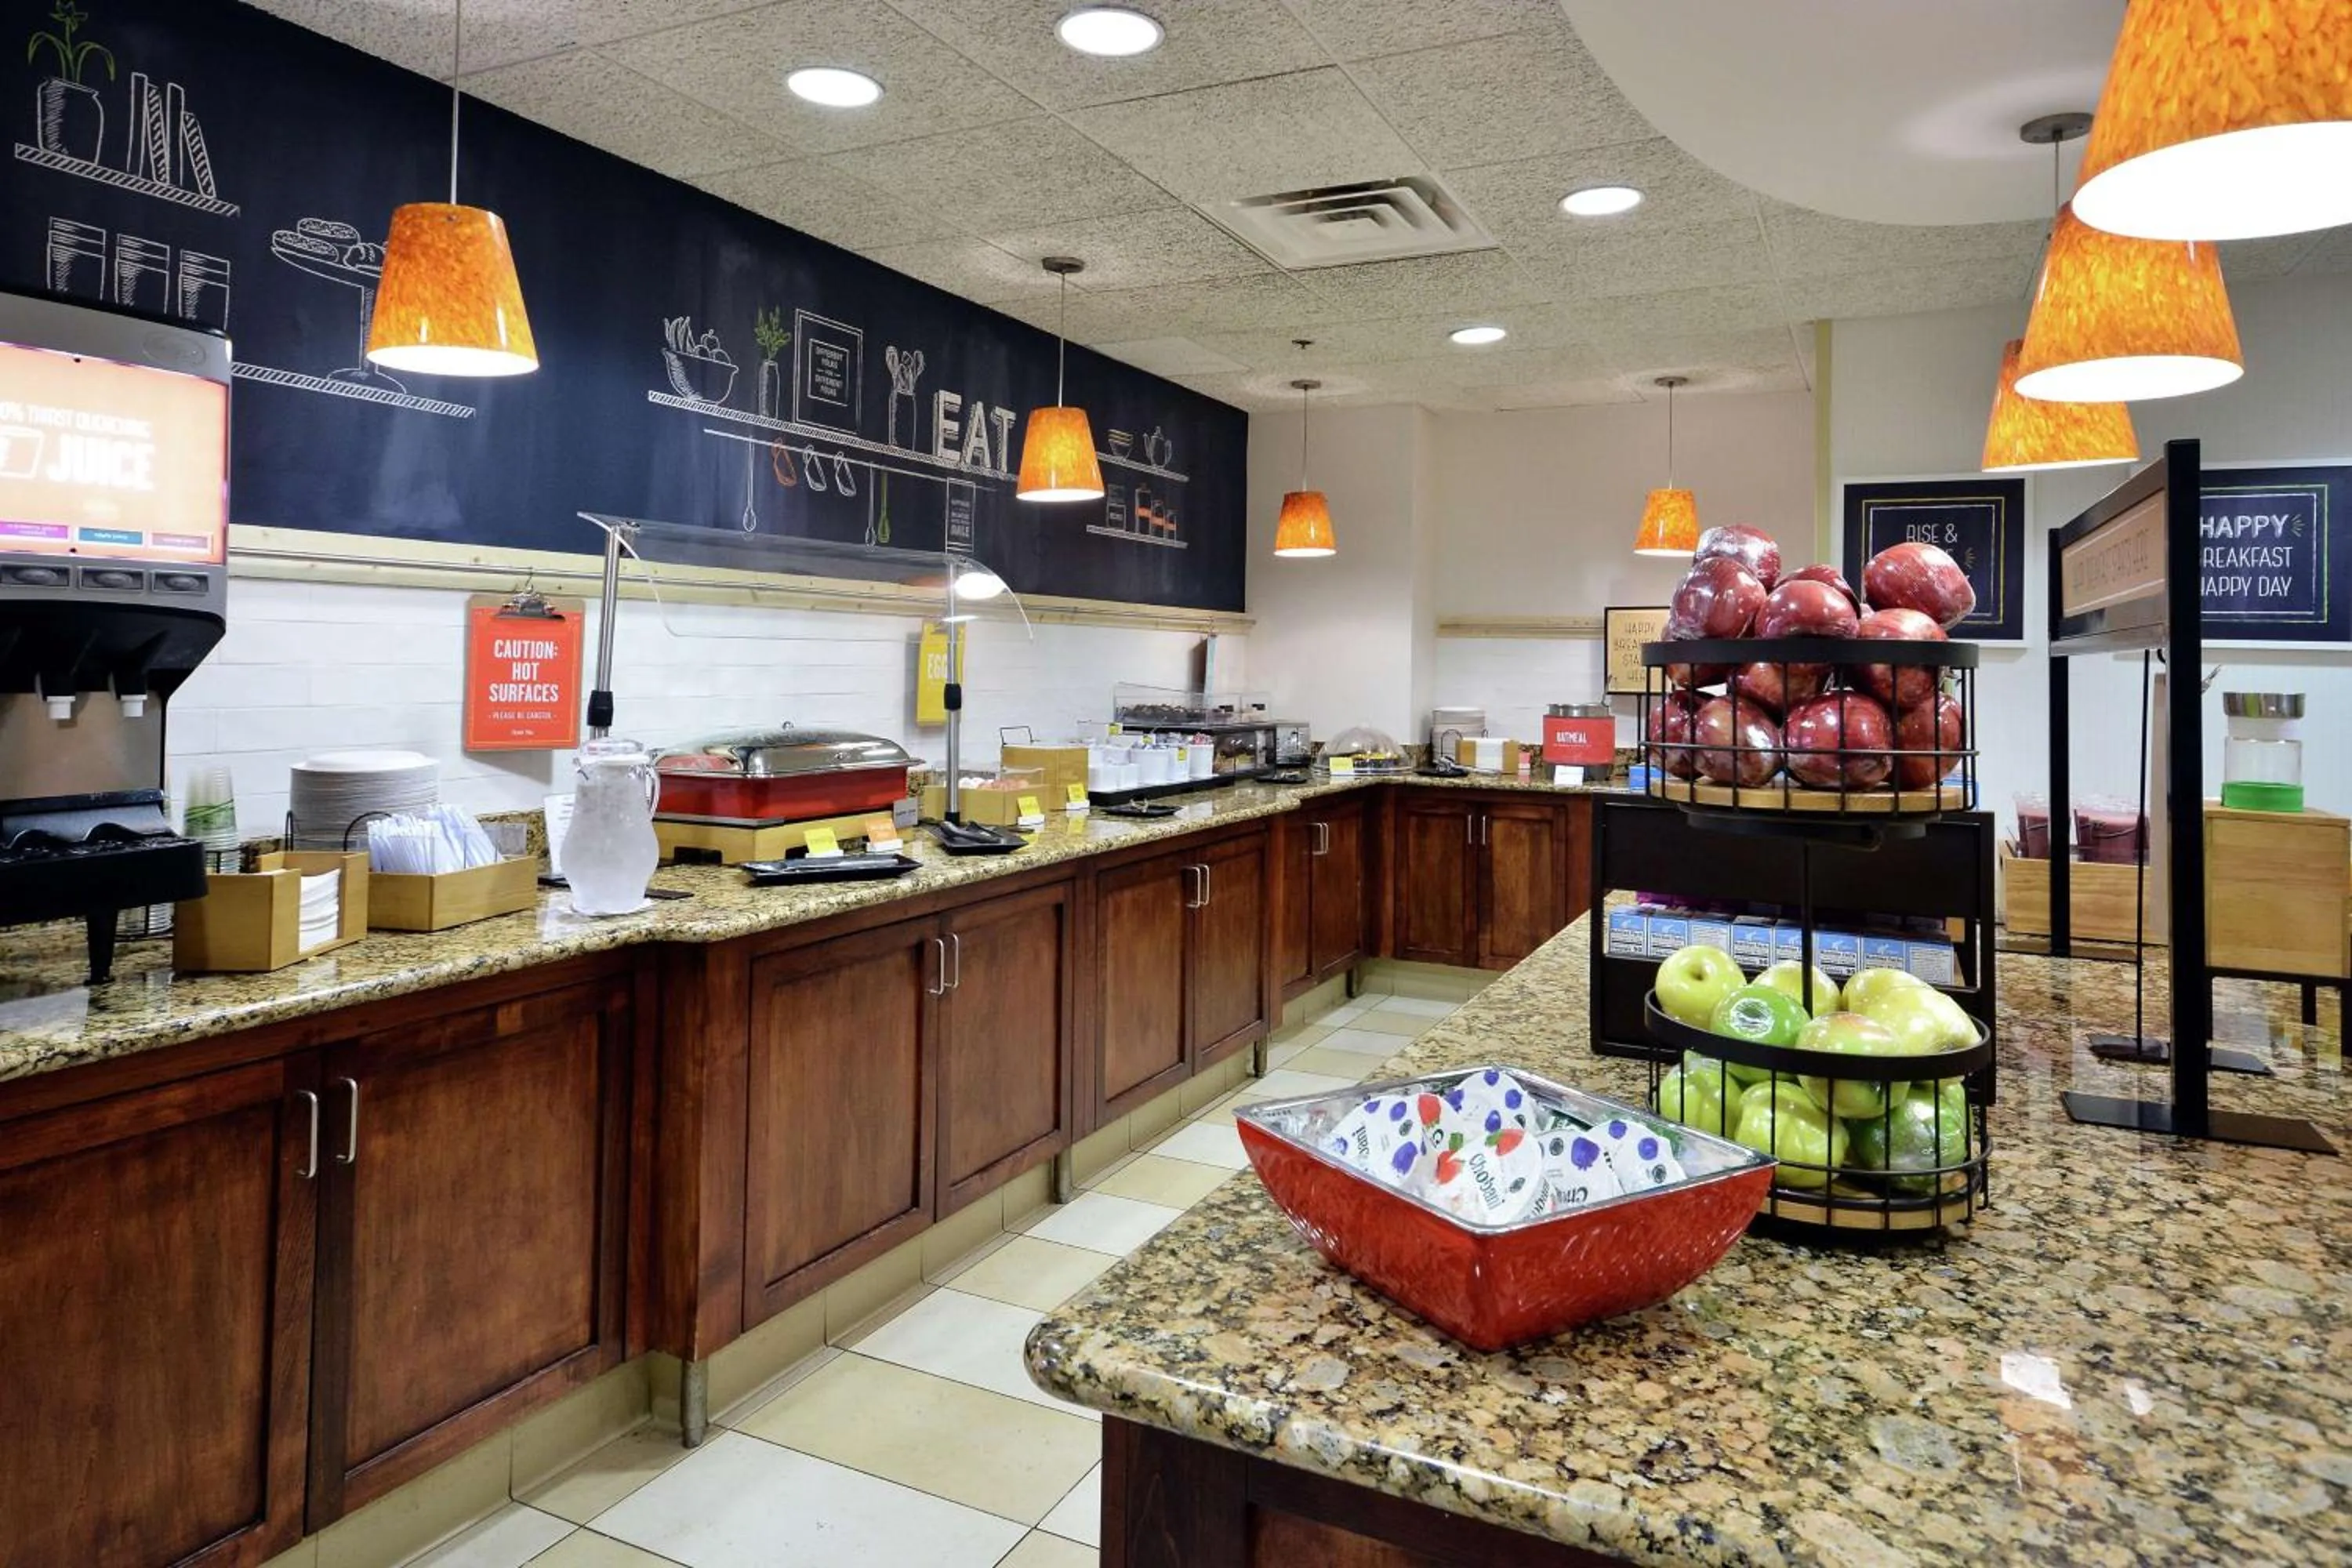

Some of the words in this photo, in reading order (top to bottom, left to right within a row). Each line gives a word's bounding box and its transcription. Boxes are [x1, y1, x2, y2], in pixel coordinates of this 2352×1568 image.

[933, 390, 1017, 474] EAT
[45, 432, 155, 492] JUICE
[1906, 524, 1940, 543] RISE
[1945, 523, 1958, 543] &
[2199, 514, 2289, 539] HAPPY
[2200, 546, 2293, 568] REAKFAST
[2259, 576, 2292, 597] DAY
[494, 639, 558, 659] CAUTION:
[512, 662, 539, 681] HOT
[488, 684, 559, 702] SURFACES
[1555, 731, 1588, 744] OATMEAL
[1468, 1152, 1506, 1210] Chobani
